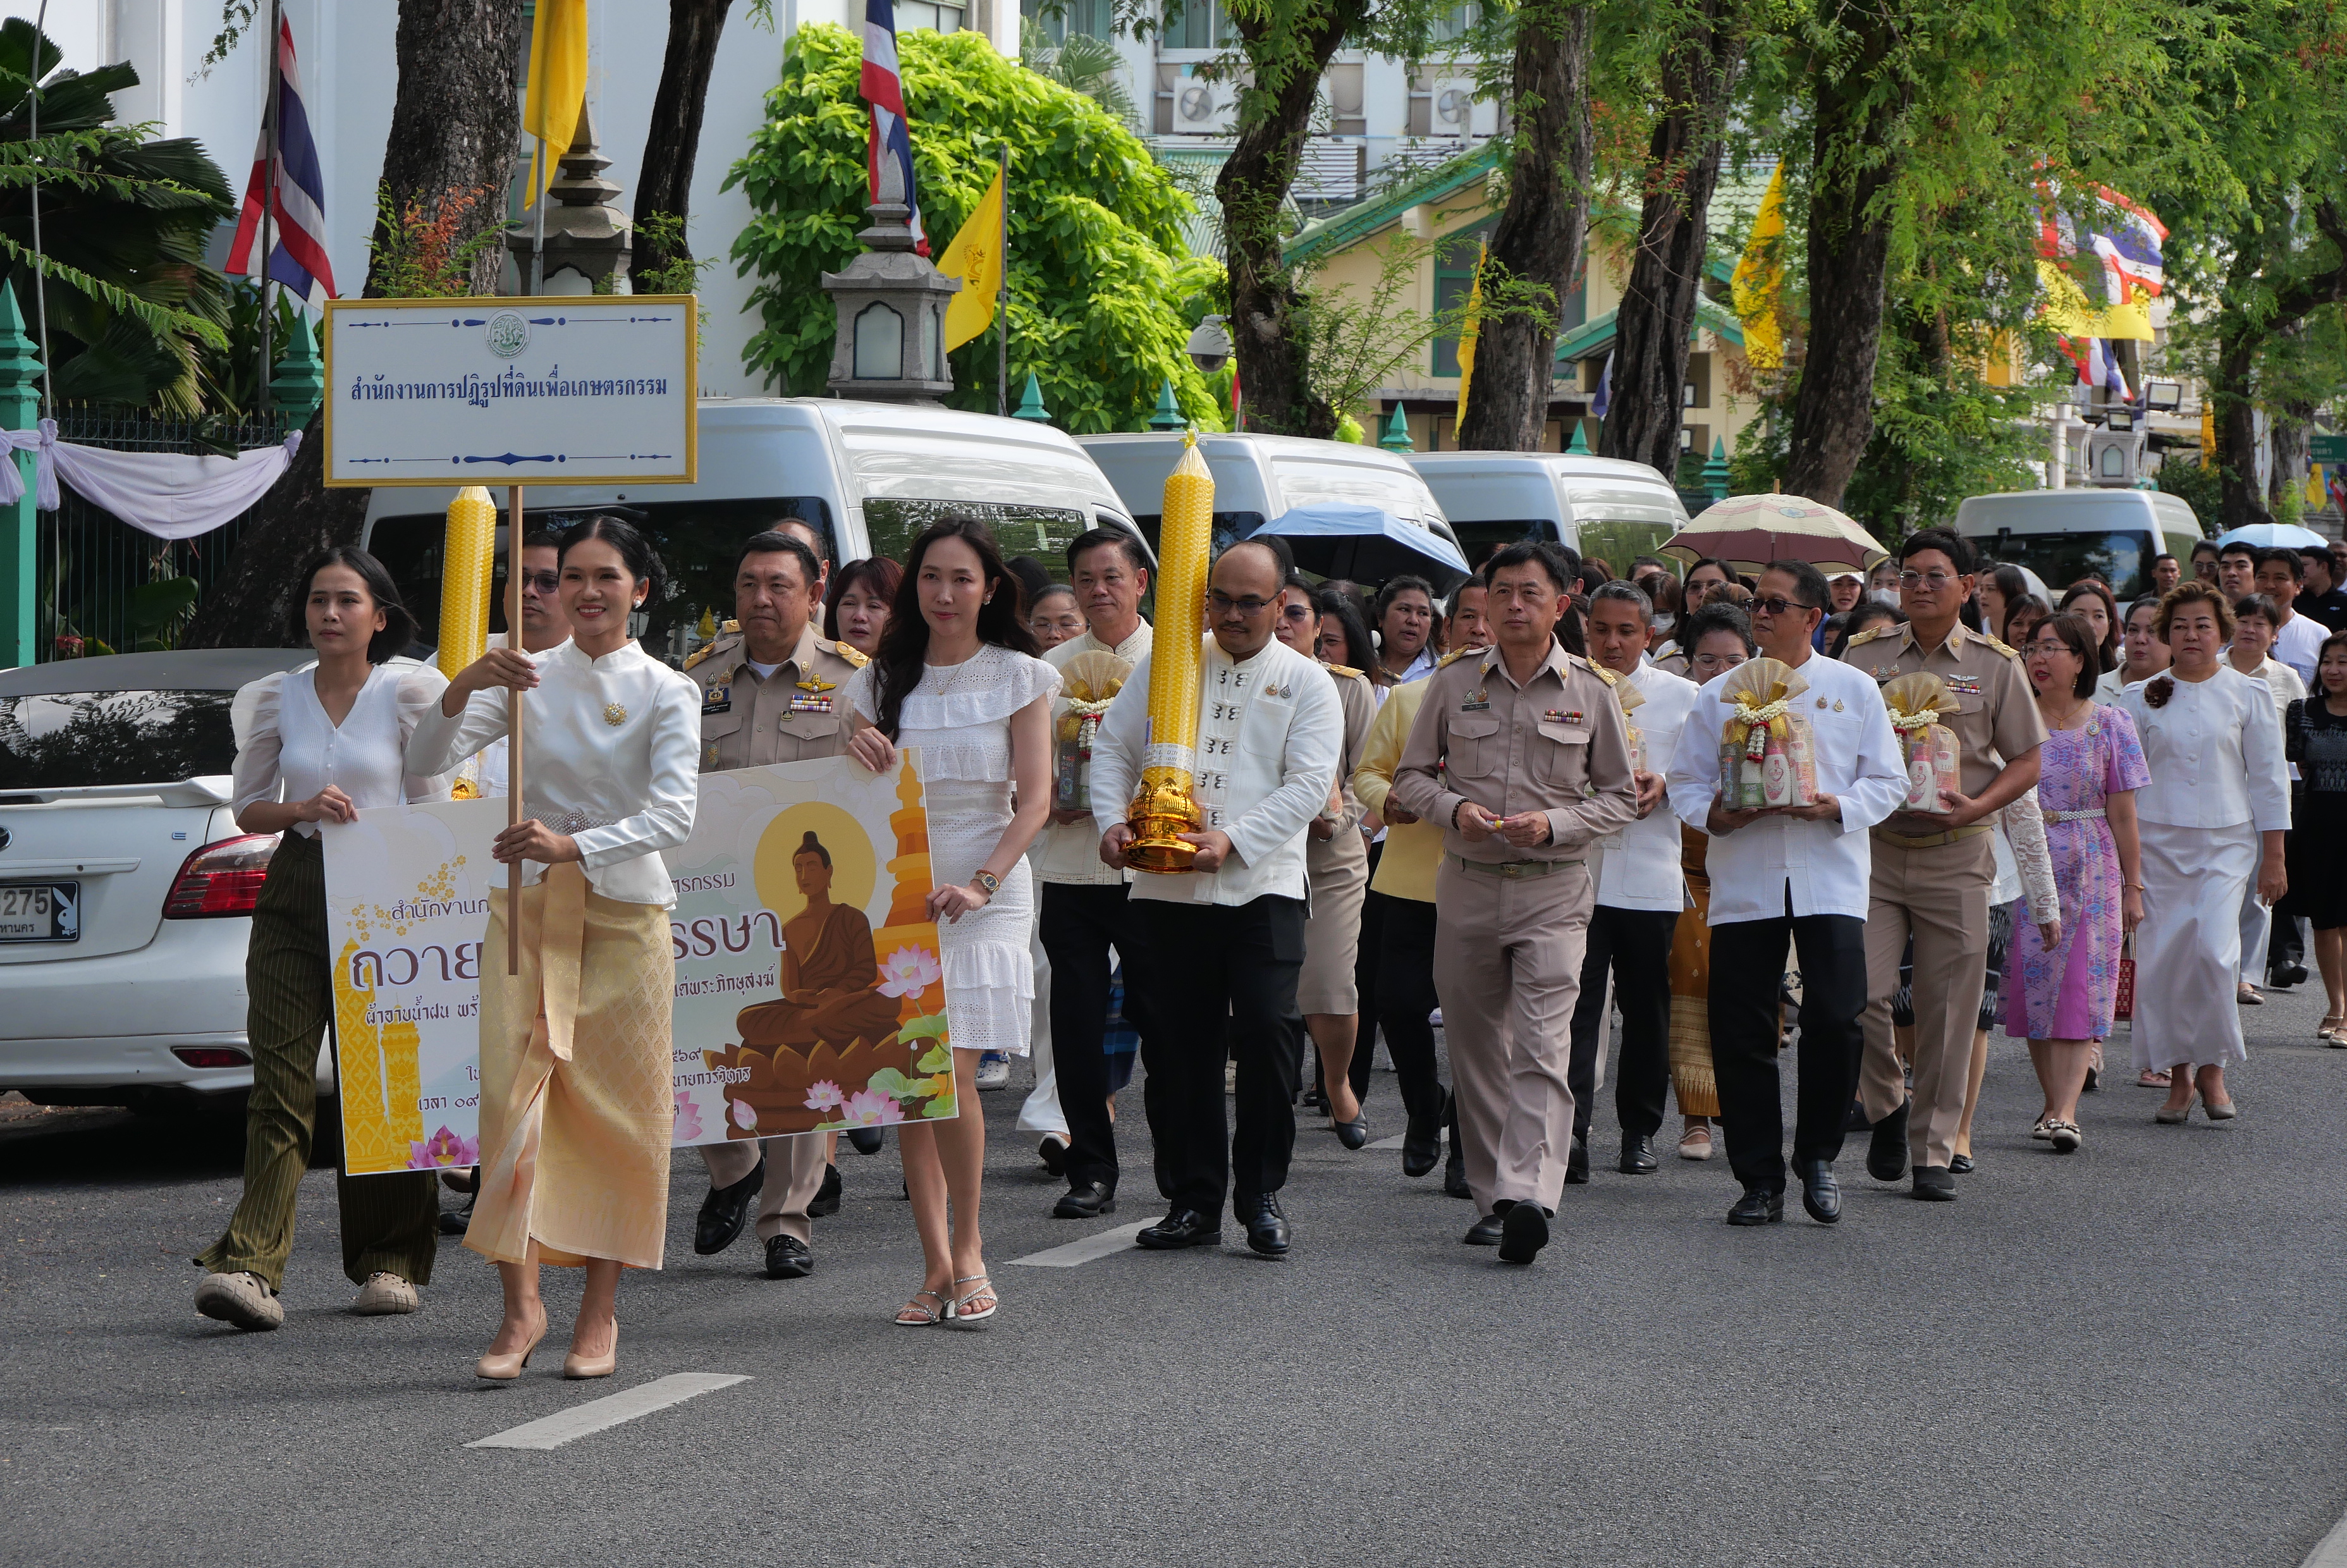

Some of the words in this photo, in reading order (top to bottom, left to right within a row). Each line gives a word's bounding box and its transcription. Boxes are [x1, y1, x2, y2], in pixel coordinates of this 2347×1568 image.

[352, 364, 666, 408] สำนักงานการปฏิรูปที่ดินเพื่อเกษตรกรรม
[0, 889, 48, 915] 275
[353, 941, 484, 988] ถวาย
[366, 995, 450, 1025] ผ้าอาบน้ำฝน
[458, 994, 480, 1017] พร้
[419, 1097, 446, 1111] เวลา
